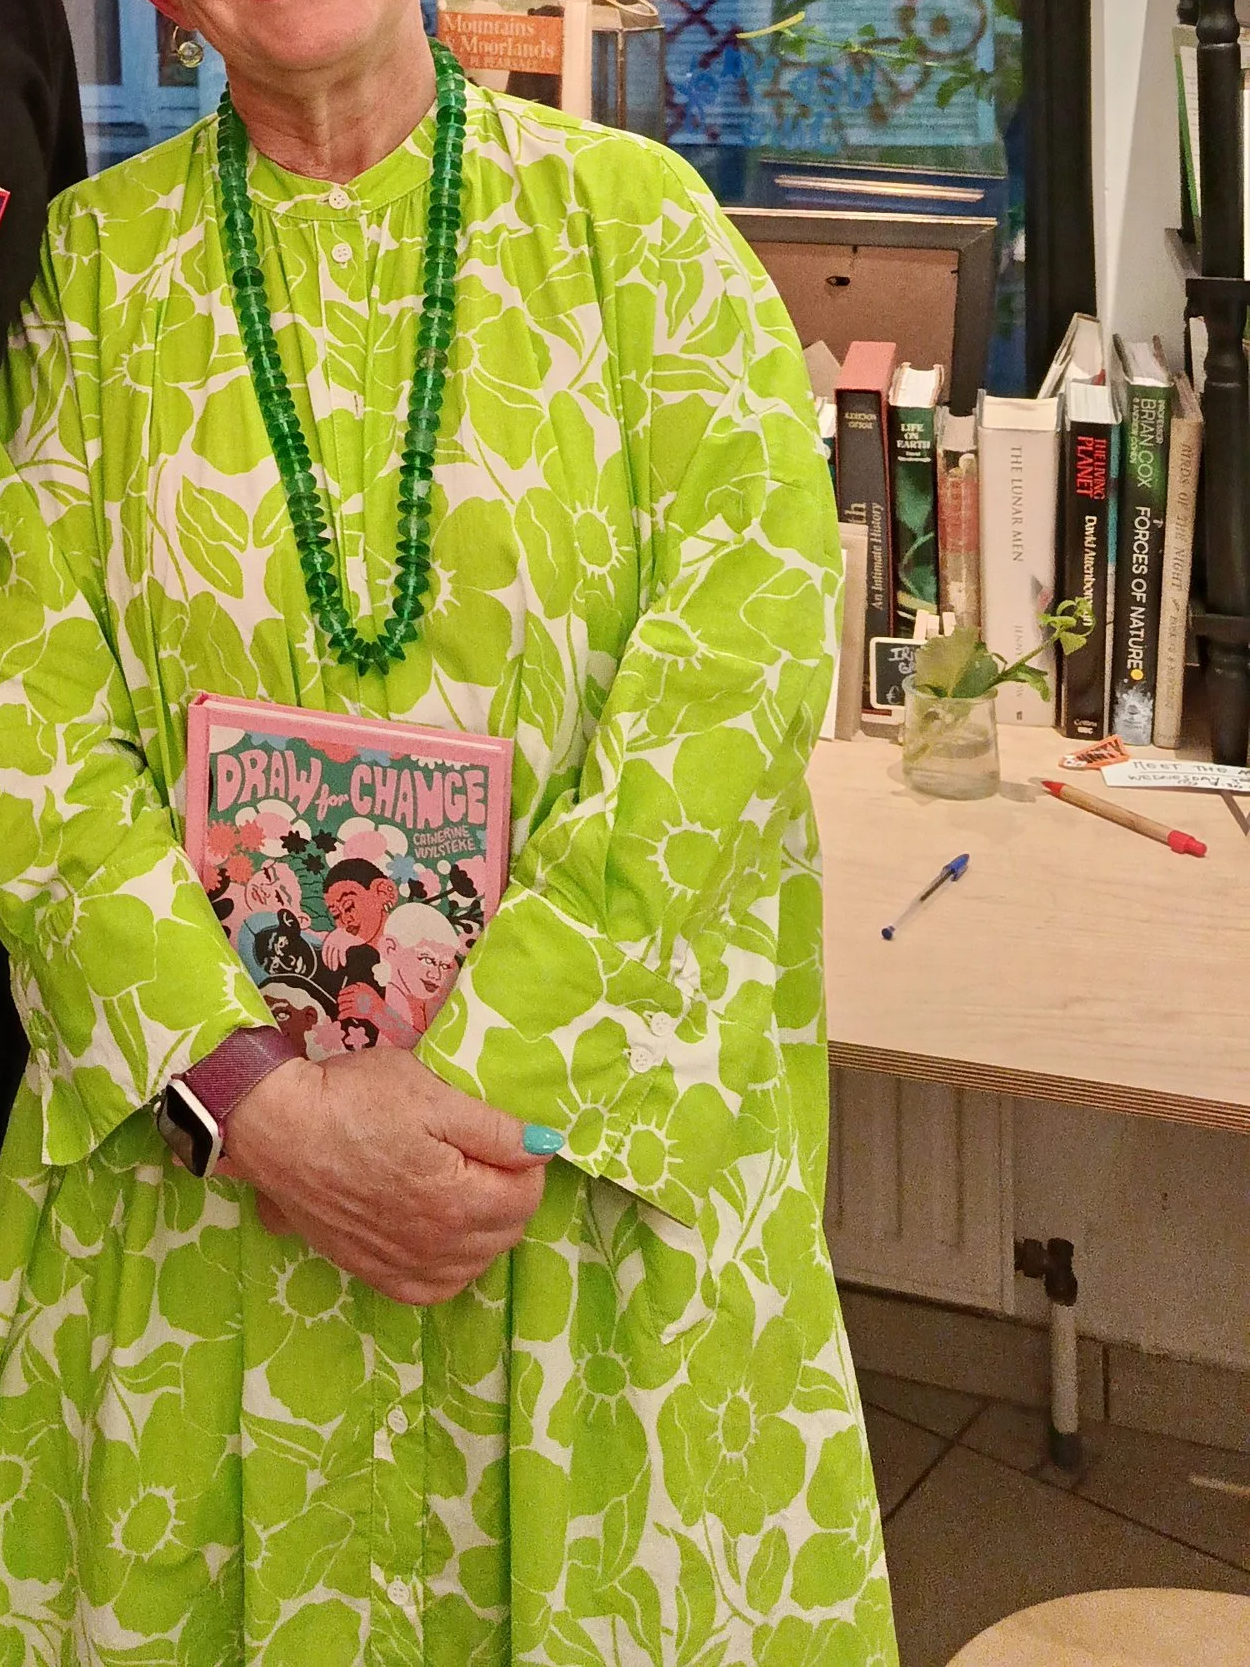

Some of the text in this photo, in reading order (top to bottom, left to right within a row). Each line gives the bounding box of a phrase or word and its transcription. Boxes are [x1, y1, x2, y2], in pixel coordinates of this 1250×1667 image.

[443, 13, 536, 37] Mountains
[460, 34, 555, 59] Moorlands
[900, 423, 925, 433] LIFE
[904, 432, 920, 441] ON
[1130, 404, 1140, 436] ANDREW
[1155, 398, 1165, 445] PROFESSOR
[896, 439, 932, 451] EARTH
[1137, 397, 1156, 489] BRIAN COX
[1075, 435, 1095, 499] PLANET
[1092, 437, 1107, 501] THE LIVING
[1010, 446, 1025, 563] THE LUNAR MEN
[1169, 442, 1193, 592] BIRDS OF THE NIGHT
[1083, 515, 1099, 547] David
[870, 502, 886, 610] An Intimate History
[1126, 505, 1151, 670] FORCES OF NATURE
[216, 749, 489, 831] DRAW for CHANGE
[413, 823, 470, 847] CATHERINE
[413, 837, 477, 860] VUYLSTEKE
